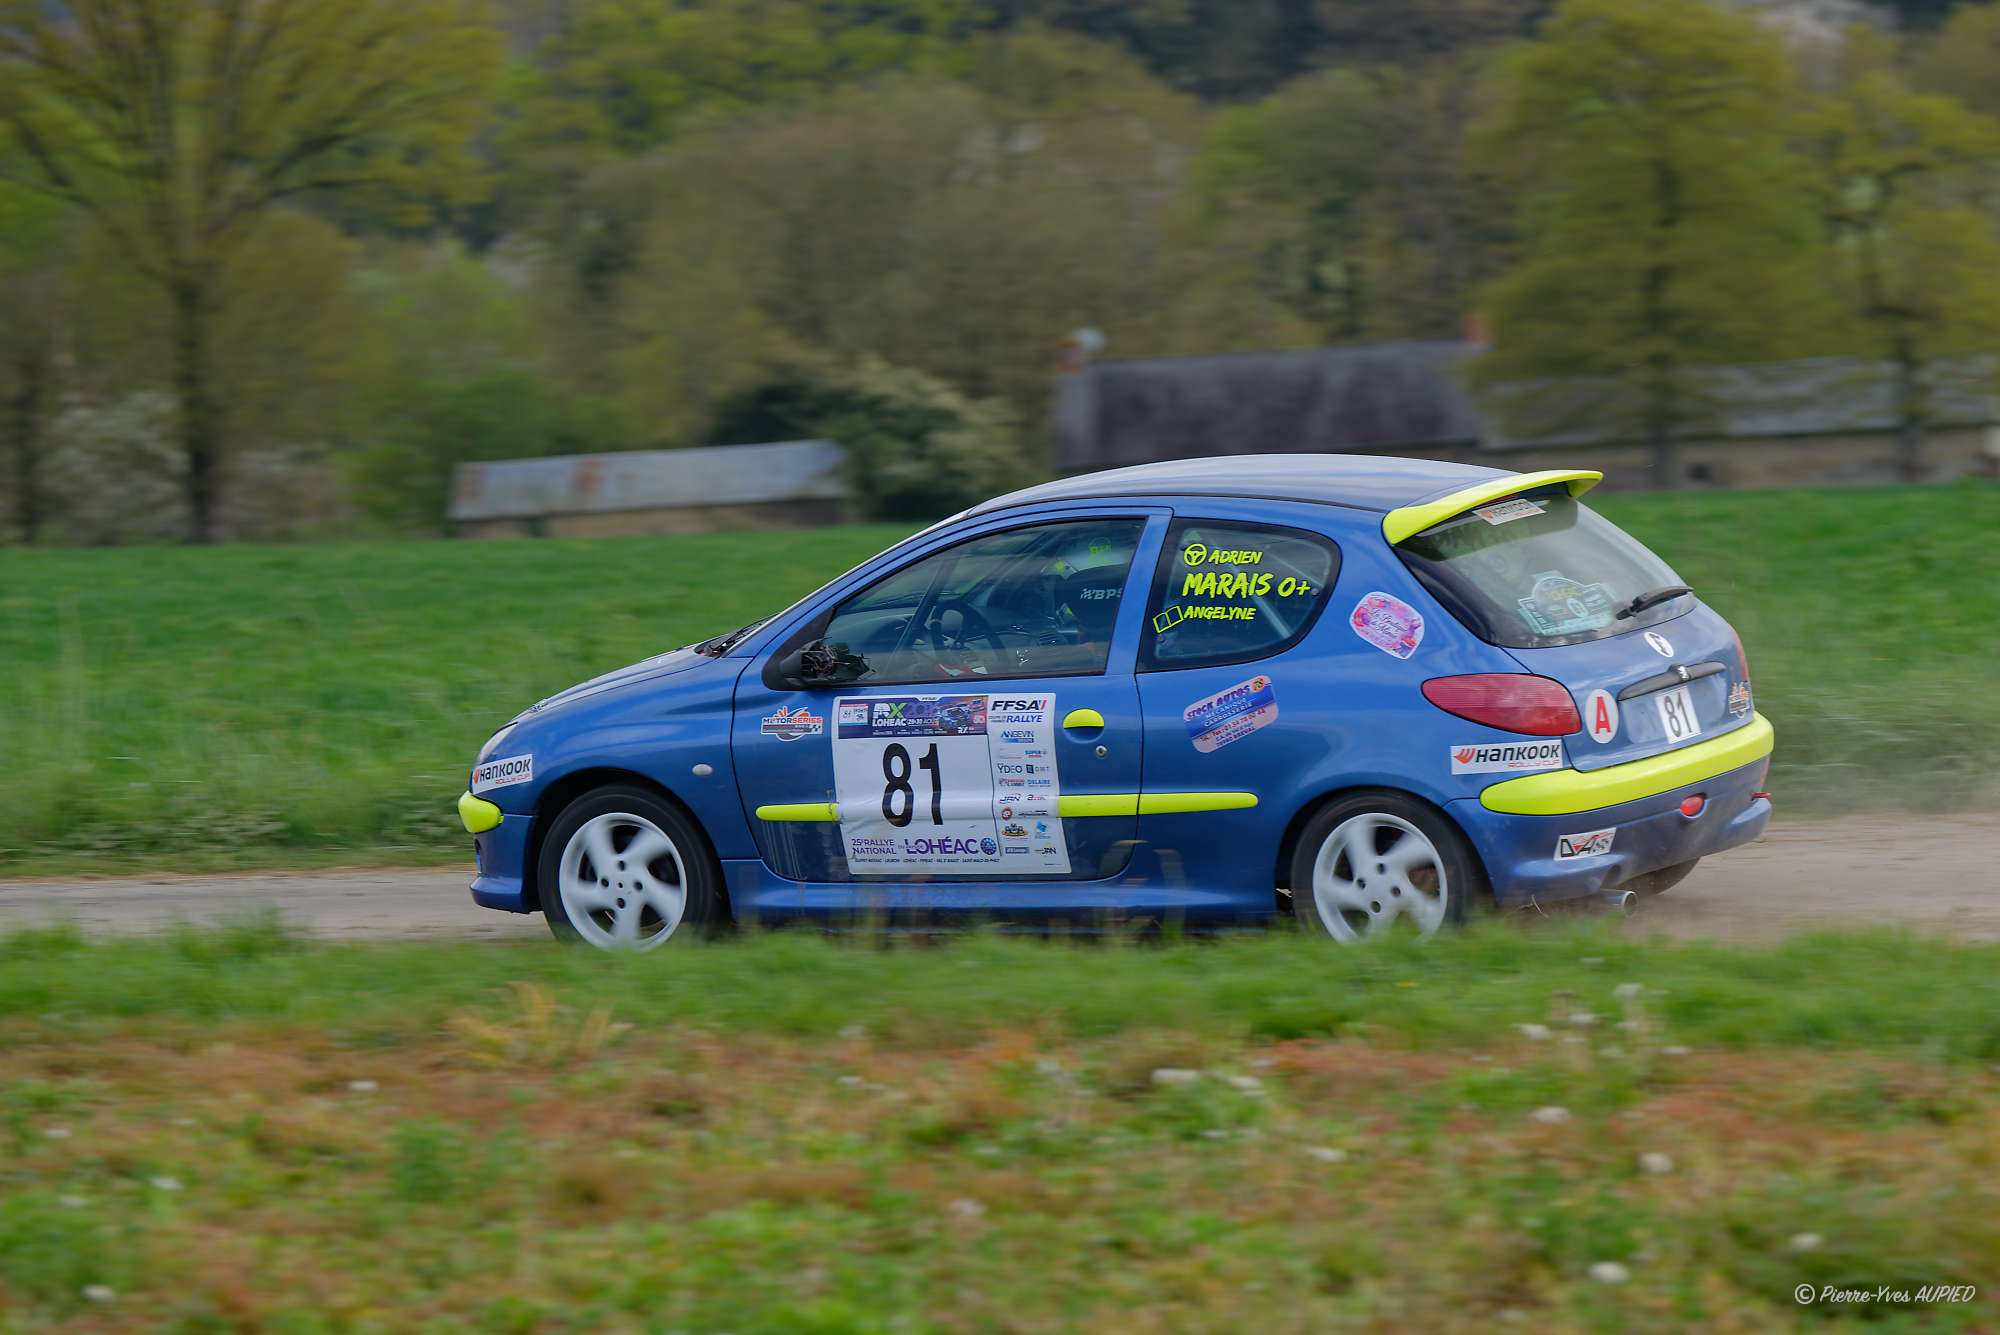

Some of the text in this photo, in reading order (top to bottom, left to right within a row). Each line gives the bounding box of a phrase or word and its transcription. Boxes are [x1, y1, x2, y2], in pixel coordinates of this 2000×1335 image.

[1208, 549, 1263, 565] ADRIEN
[1181, 571, 1275, 599] MARAIS
[1183, 605, 1257, 621] ANGELYNE
[991, 699, 1041, 711] FFSA
[1006, 714, 1043, 723] RALLYE
[1594, 695, 1613, 735] A
[1663, 692, 1693, 738] 81
[881, 742, 944, 828] 81
[852, 836, 980, 855] NATIONAL LOHÉAC
[864, 838, 895, 847] RALLYE
